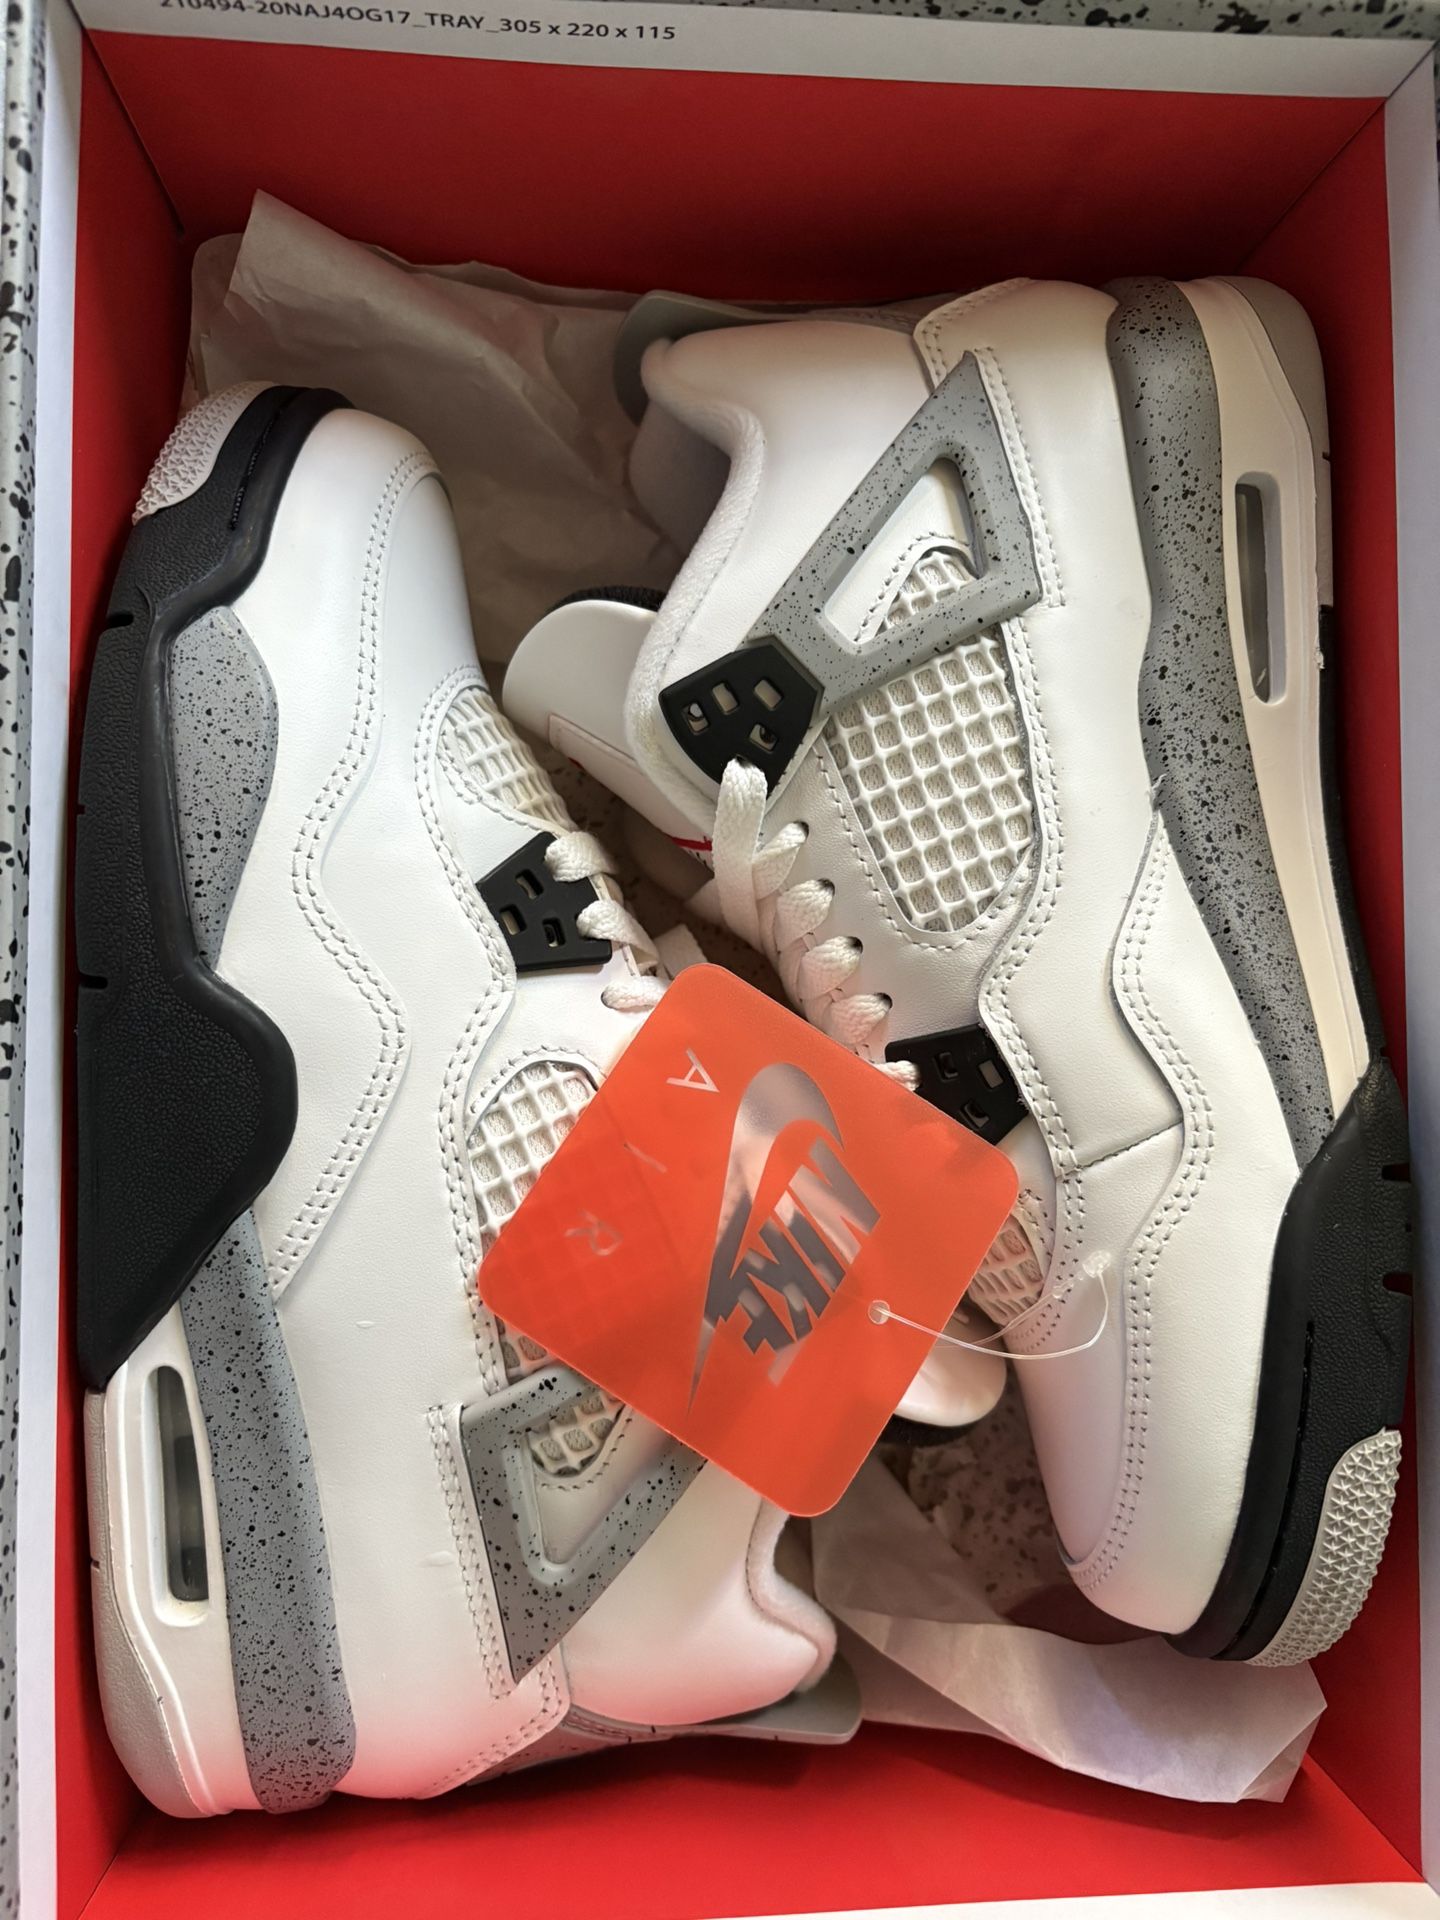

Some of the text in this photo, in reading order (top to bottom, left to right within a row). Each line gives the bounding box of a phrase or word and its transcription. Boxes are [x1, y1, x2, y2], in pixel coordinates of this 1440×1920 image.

[548, 24, 561, 35] x
[567, 23, 609, 37] 220
[615, 27, 628, 38] x
[636, 25, 676, 40] 115
[723, 1137, 881, 1388] NIKE
